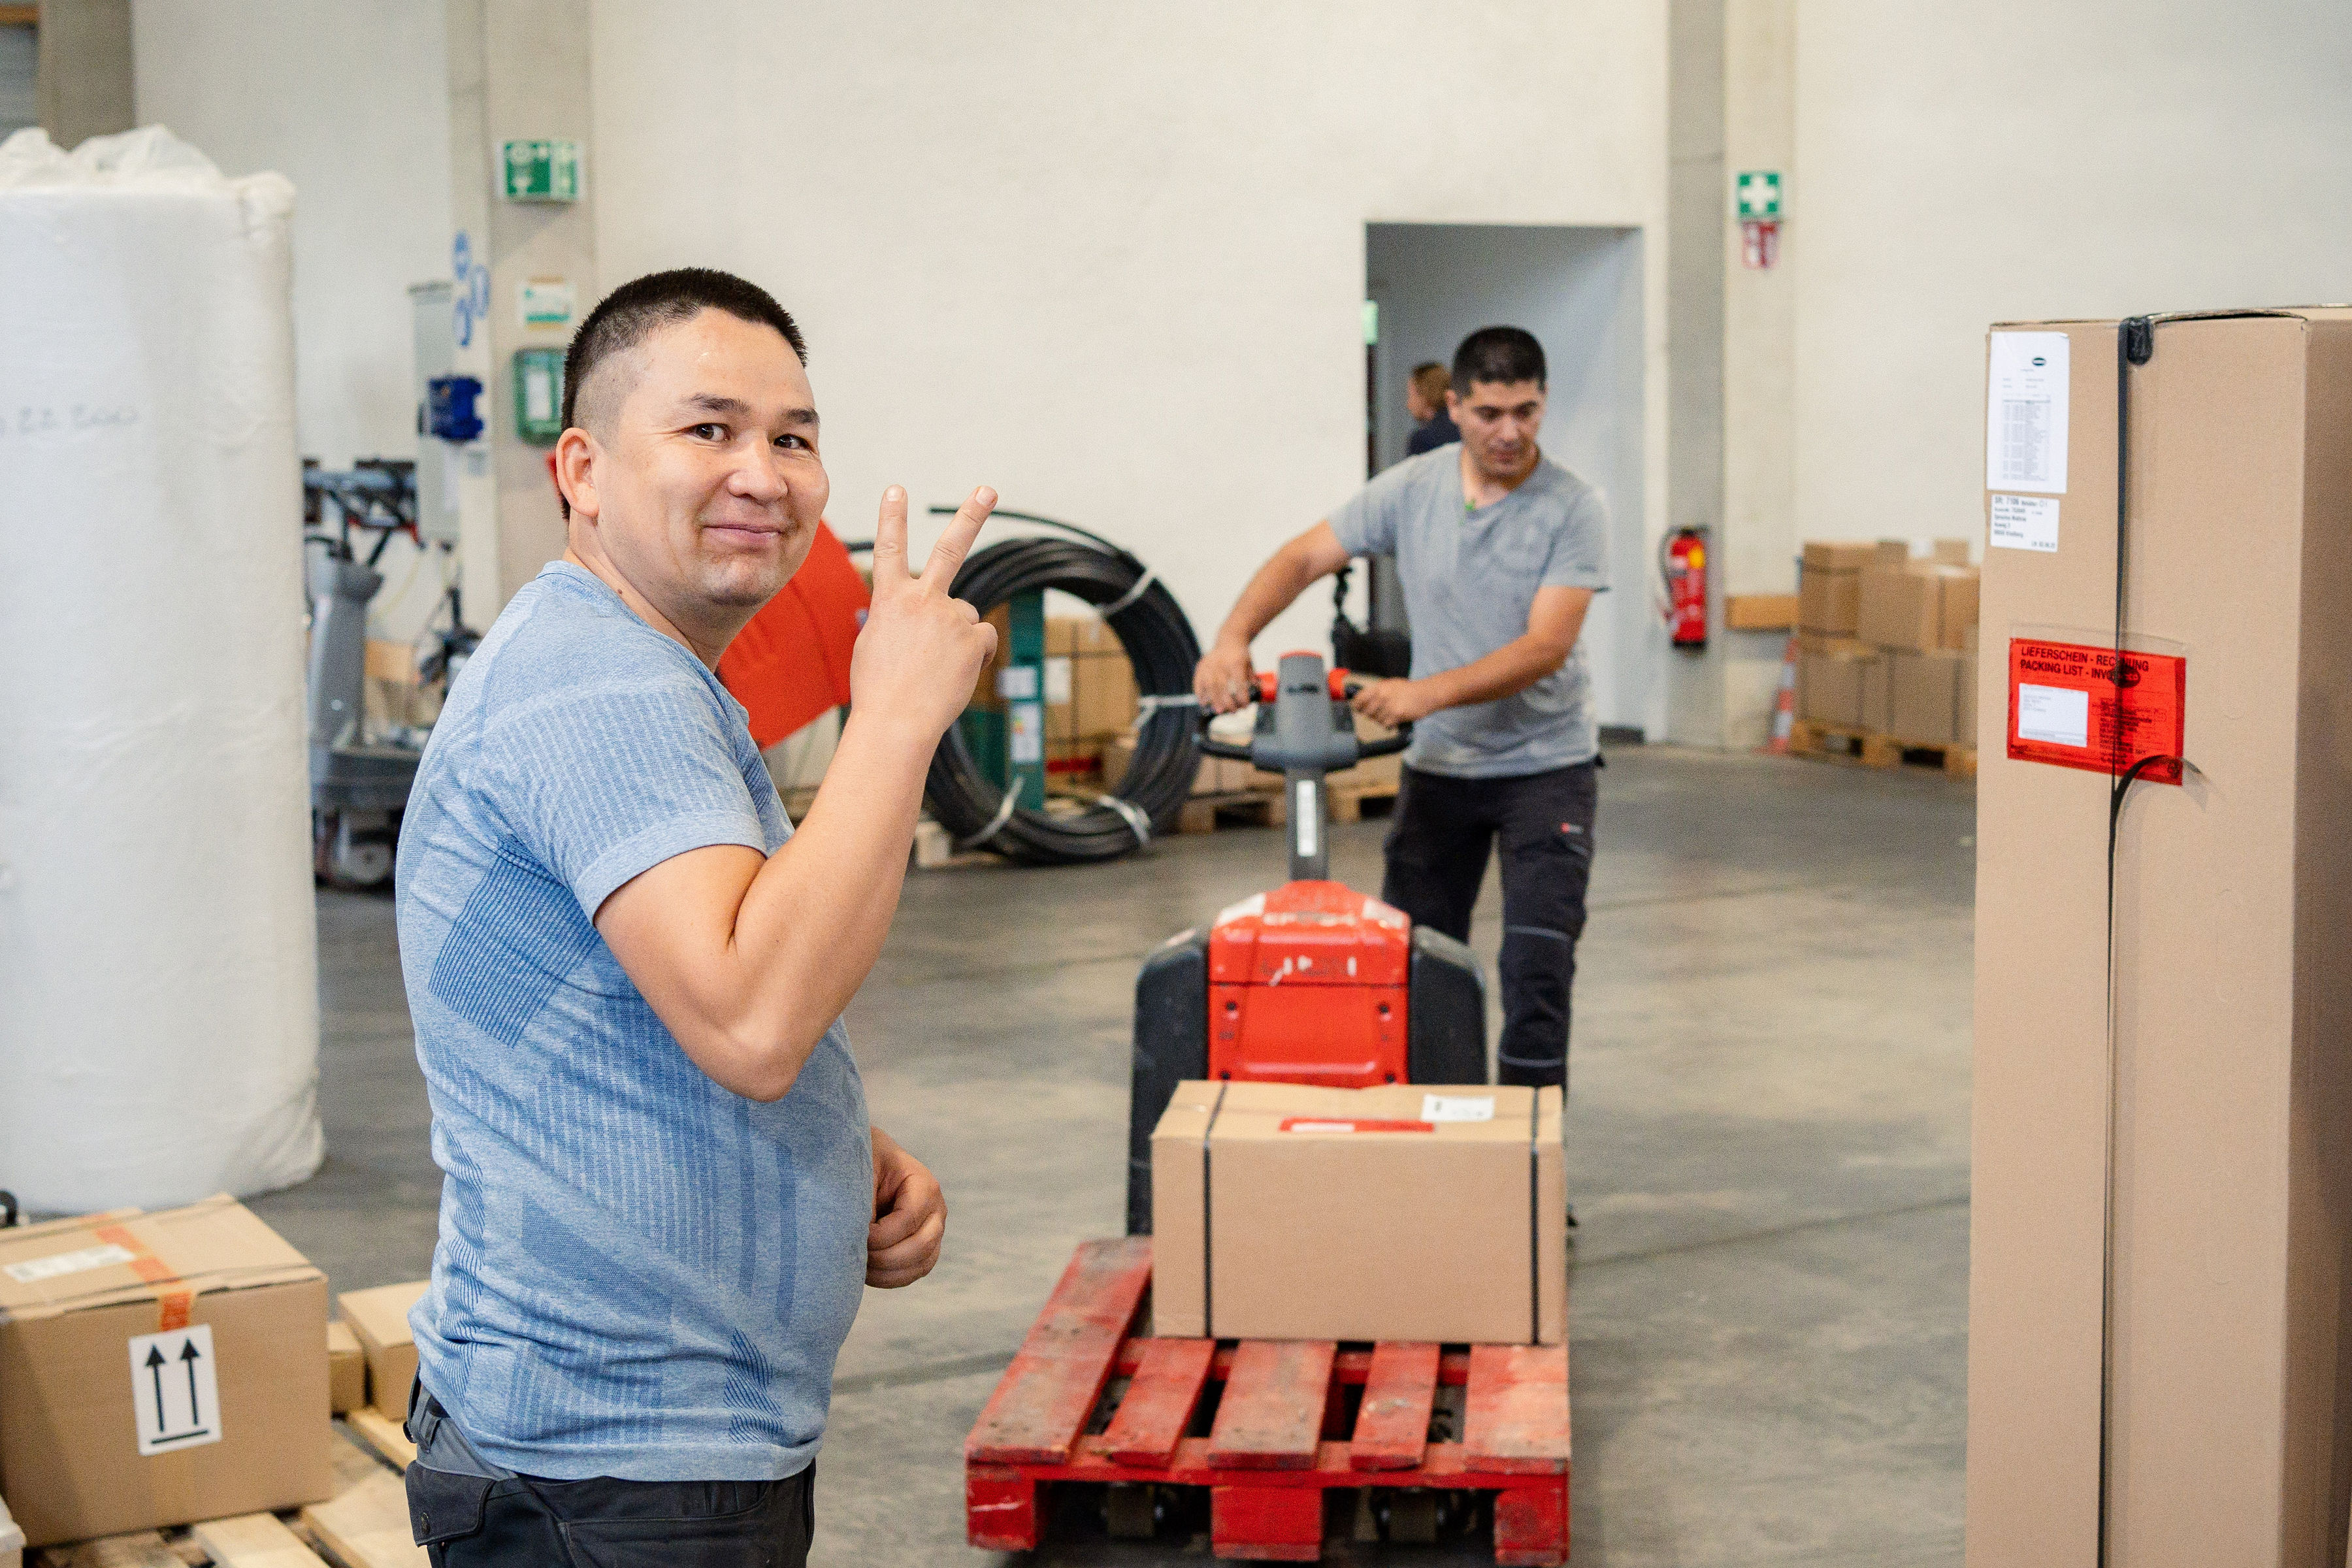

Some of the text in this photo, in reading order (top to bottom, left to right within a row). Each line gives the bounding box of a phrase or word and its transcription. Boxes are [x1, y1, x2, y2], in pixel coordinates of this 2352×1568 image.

[2021, 646, 2088, 663] LIEFERSCHEIN
[2020, 659, 2061, 674] PACKING
[2063, 664, 2083, 677] LIST
